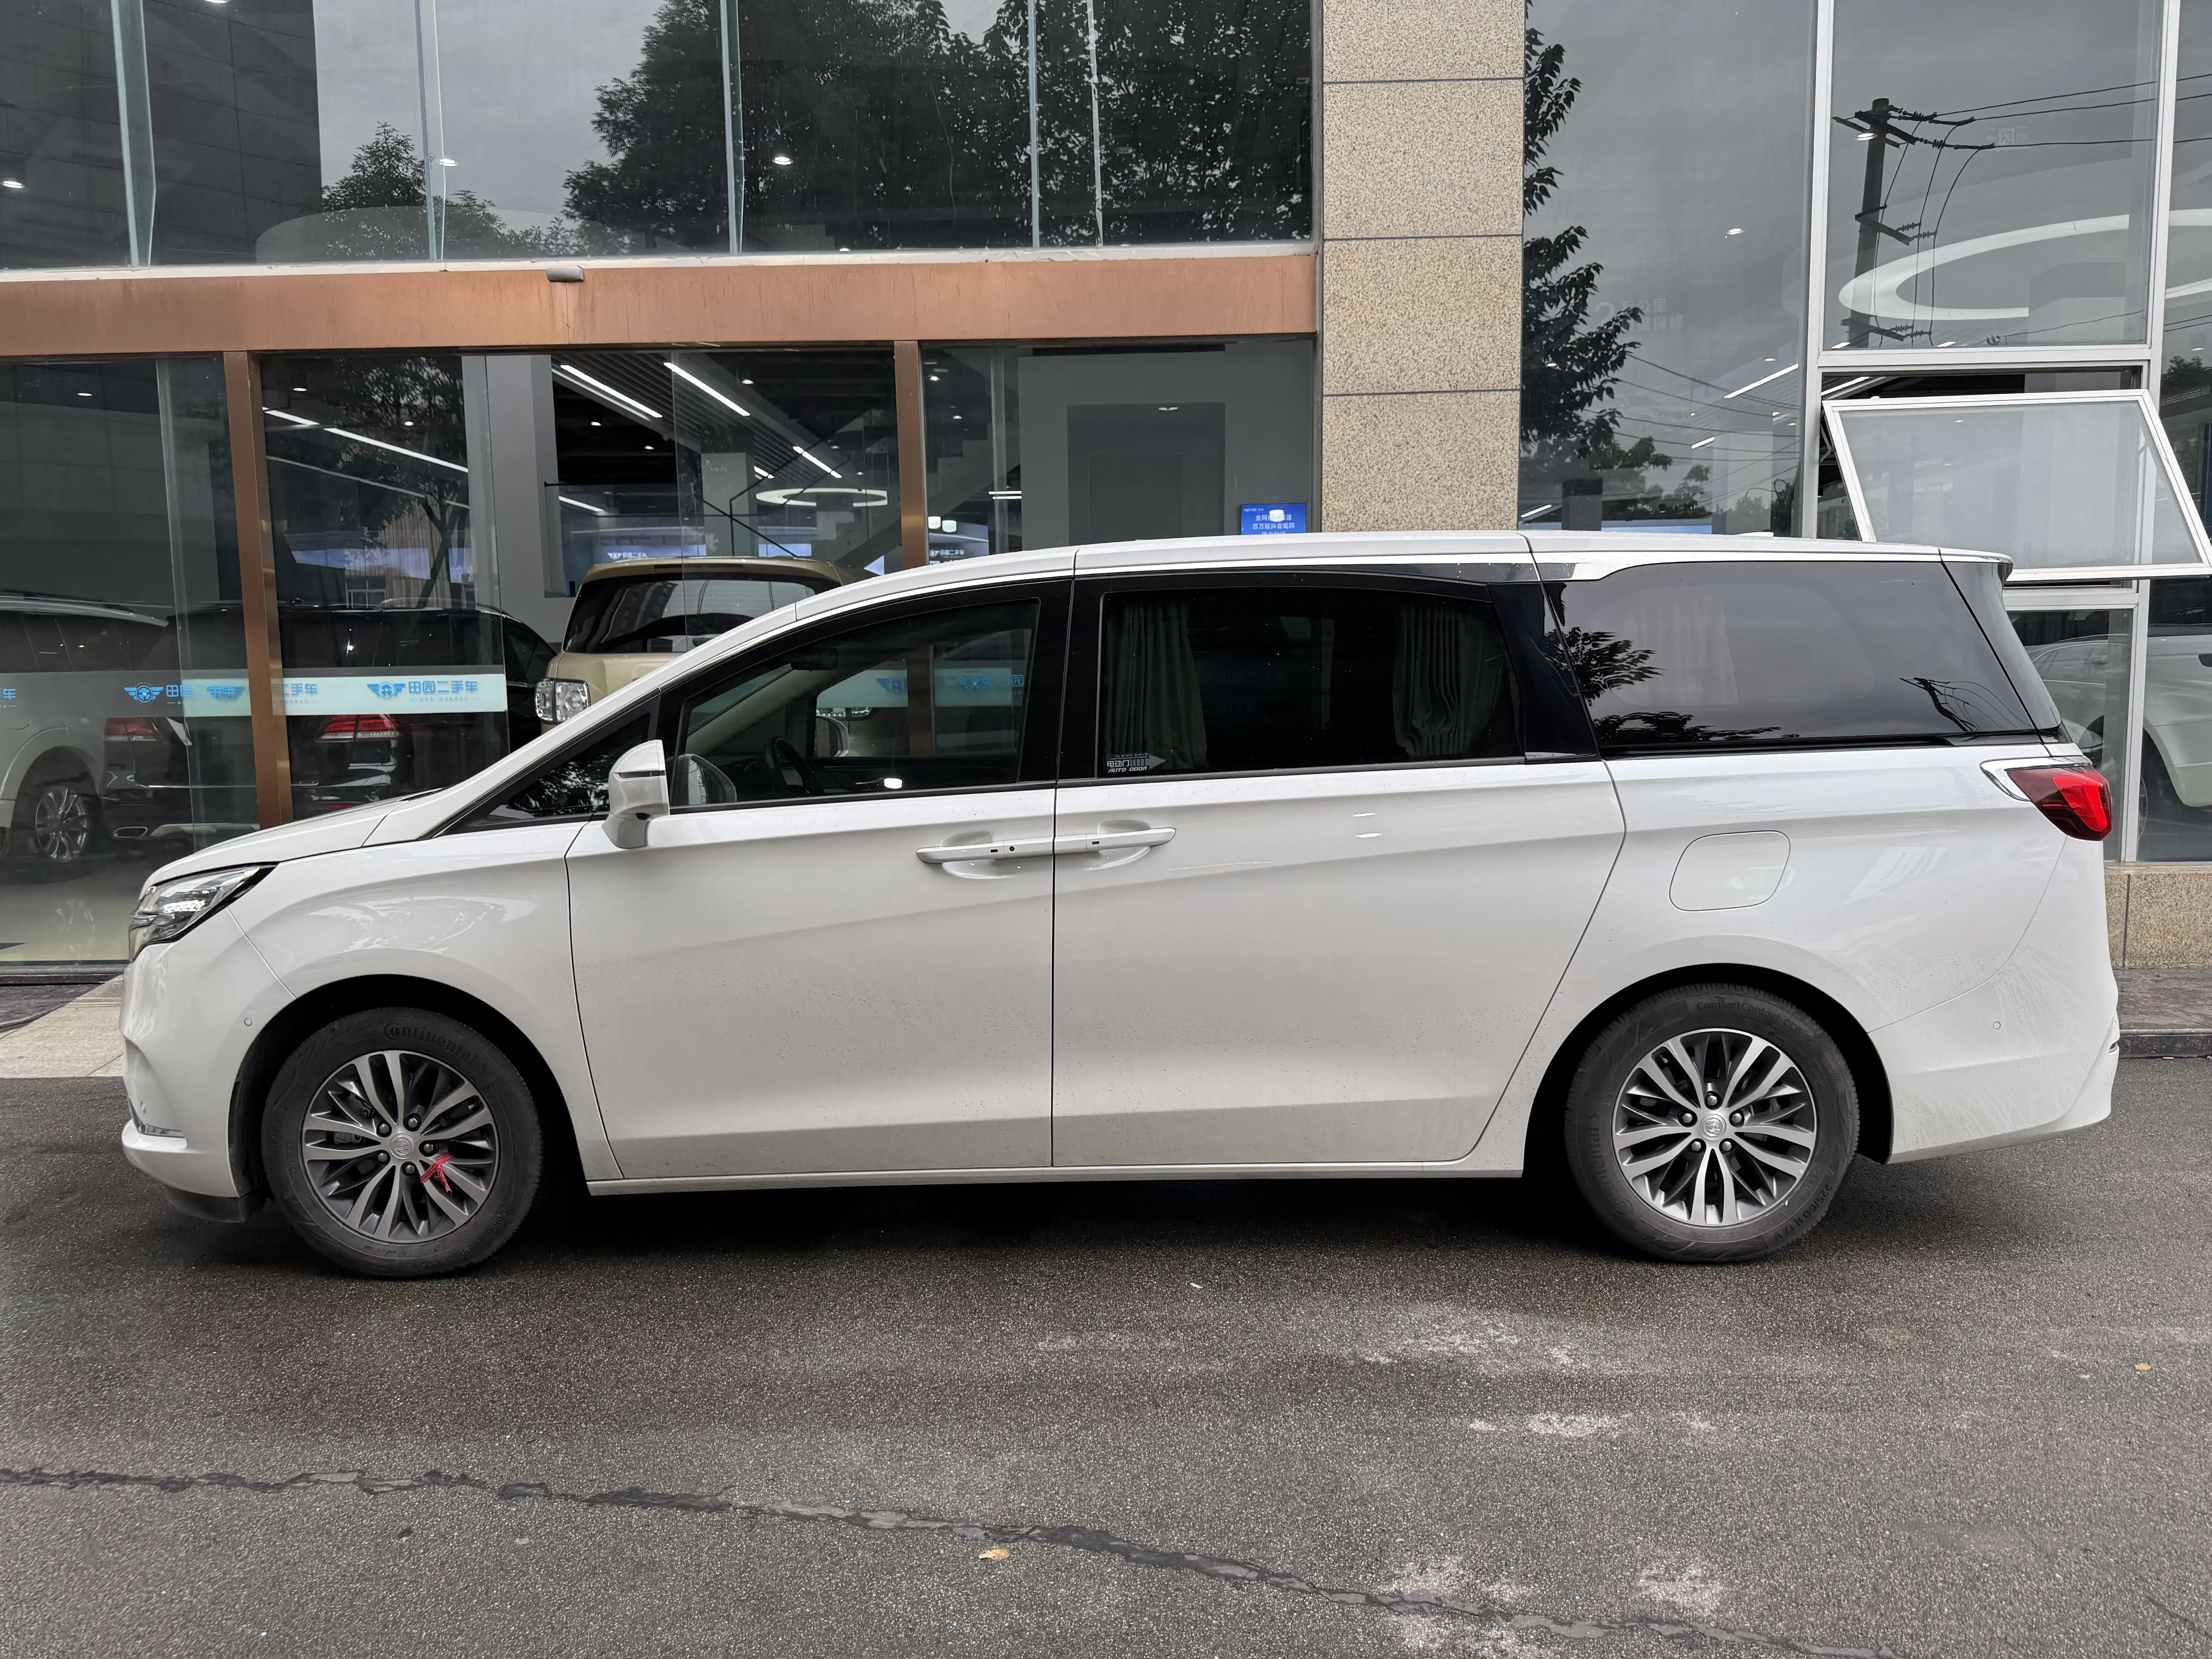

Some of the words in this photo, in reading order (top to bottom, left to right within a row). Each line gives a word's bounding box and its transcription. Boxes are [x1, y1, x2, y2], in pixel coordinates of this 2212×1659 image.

[409, 680, 478, 694] 田园二手车
[1106, 759, 1130, 768] 电动门
[1697, 1000, 1781, 1022] ComfortContact
[1783, 1018, 1803, 1035] CC6
[381, 1022, 478, 1069] Continental
[1802, 1183, 1832, 1220] 225/60
